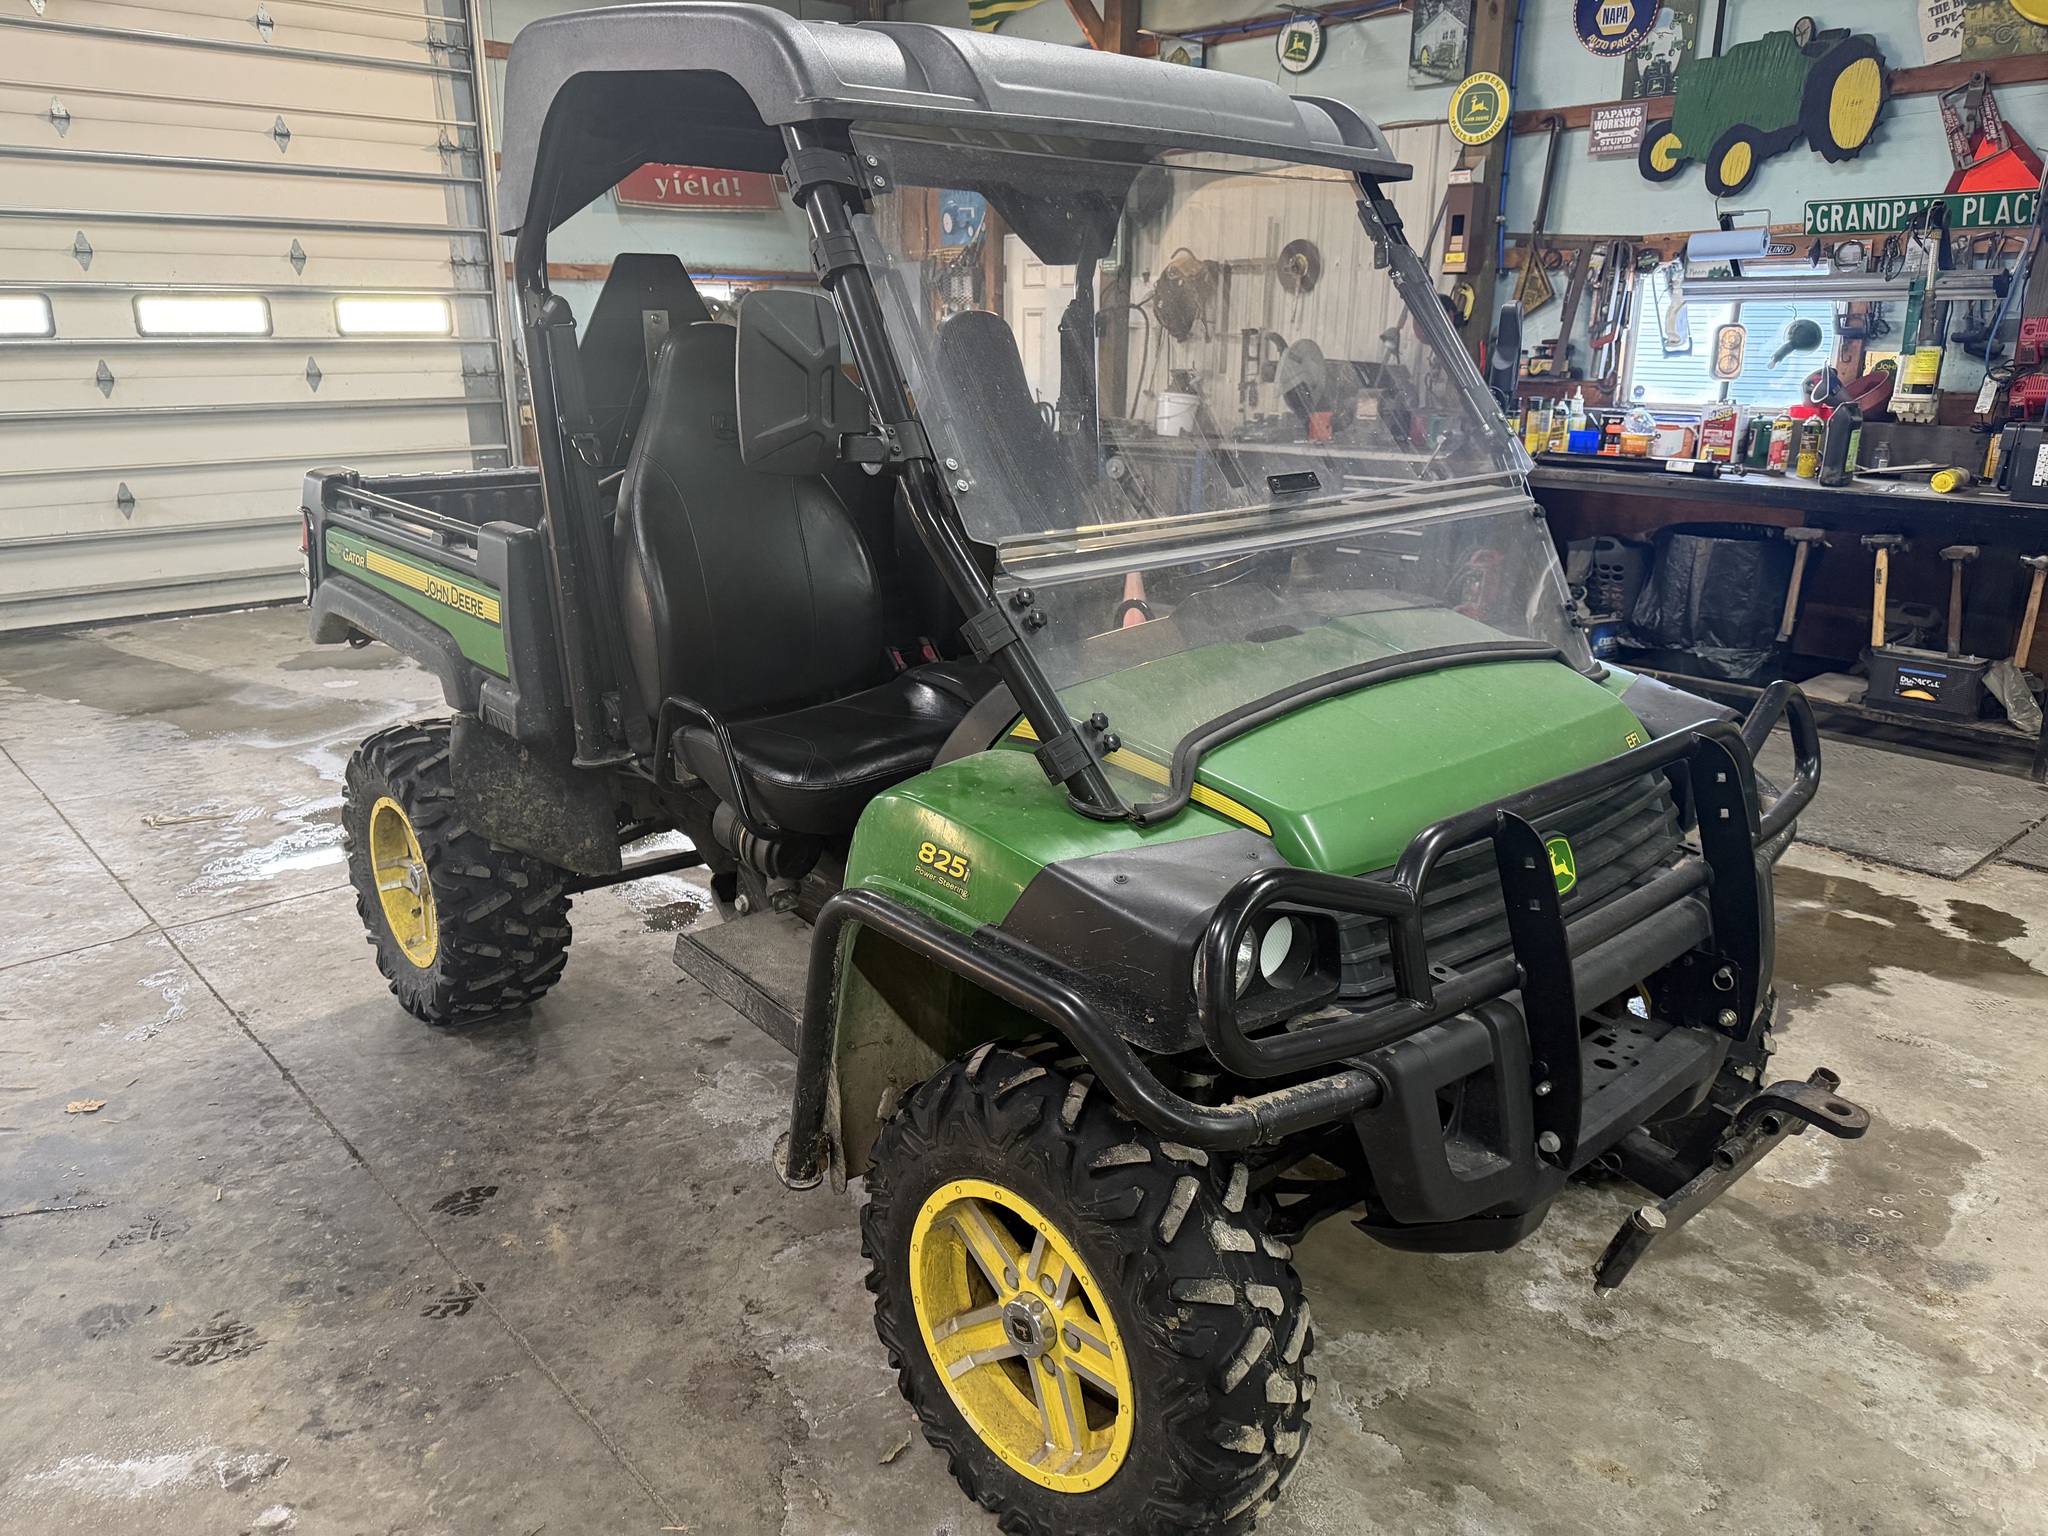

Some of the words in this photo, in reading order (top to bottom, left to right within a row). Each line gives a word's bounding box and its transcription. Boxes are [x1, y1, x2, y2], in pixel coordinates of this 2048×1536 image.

[1602, 5, 1629, 26] NAPA
[1927, 1, 1950, 17] THE
[1934, 11, 1957, 28] FIVE
[1587, 33, 1609, 50] AUTO
[1610, 28, 1640, 50] PARTS
[1456, 73, 1505, 95] EQUIPMENT
[1593, 116, 1643, 131] WORKSHOP
[1596, 107, 1642, 120] PAPAW'S
[1450, 120, 1467, 141] PARTS
[1475, 115, 1504, 142] SERVICE
[1599, 136, 1632, 146] STUPID
[654, 171, 742, 199] yield!
[1816, 199, 1942, 233] GRANDP'
[343, 547, 365, 569] GATOR
[425, 576, 449, 603] JOHN
[450, 585, 484, 617] DEERE
[1900, 675, 1941, 689] DURACELL
[1625, 731, 1641, 749] EFI
[918, 841, 970, 882] 825i
[914, 865, 937, 881] Power
[937, 876, 969, 898] Steering
